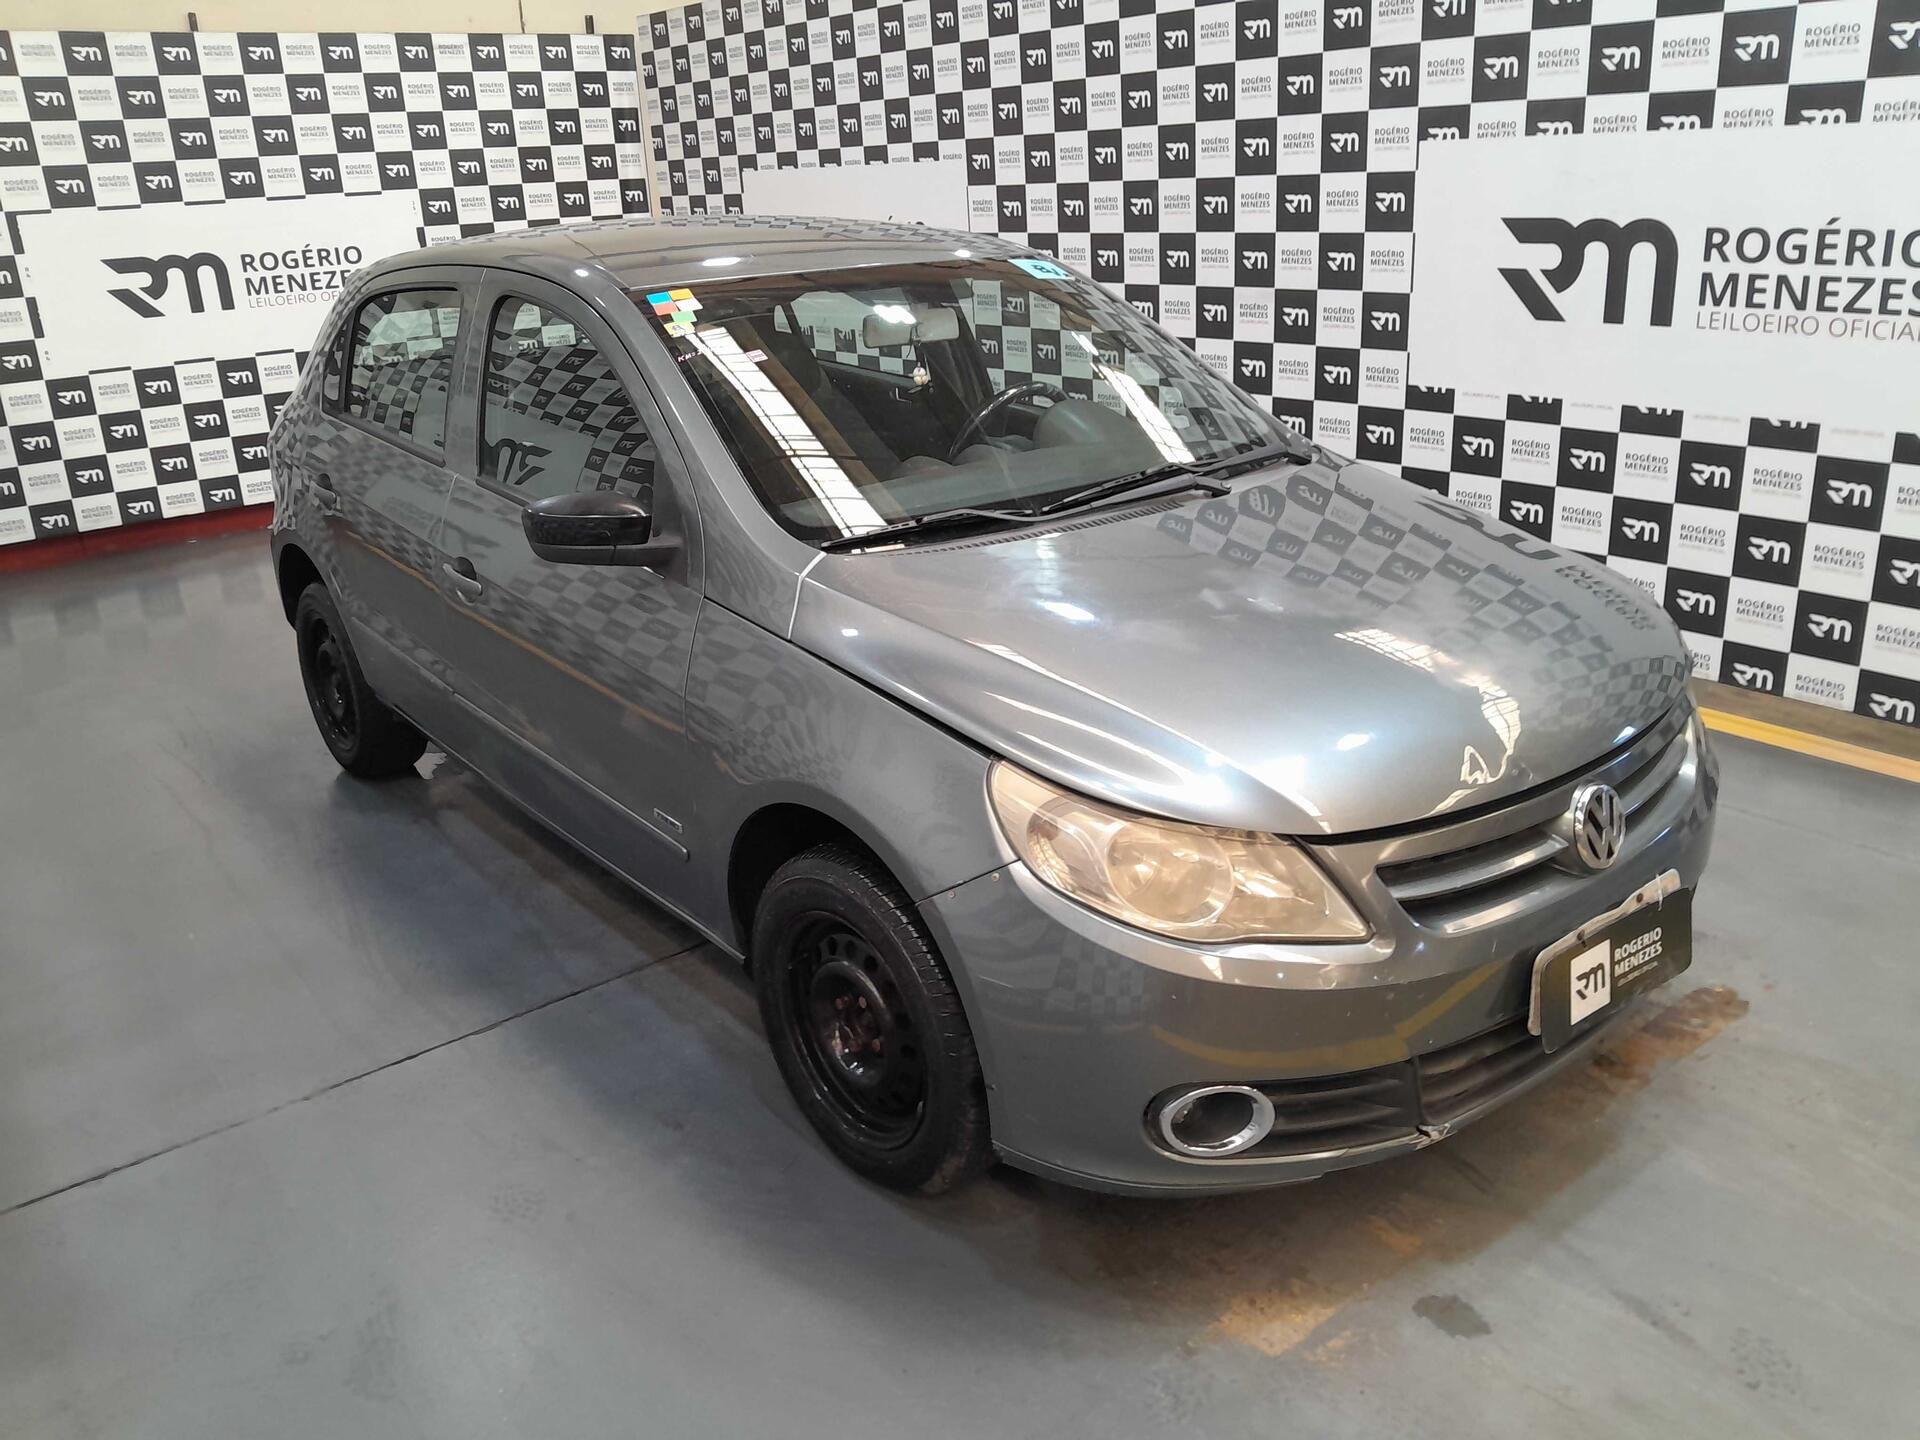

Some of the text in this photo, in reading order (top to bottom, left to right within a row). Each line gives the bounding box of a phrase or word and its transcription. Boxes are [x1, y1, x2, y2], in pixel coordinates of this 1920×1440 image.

[1285, 18, 1317, 29] MENEZES
[1804, 35, 1860, 48] MENEZES
[1662, 47, 1710, 59] MENEZES
[1537, 57, 1580, 69] MENEZES
[1427, 67, 1465, 77] MENEZES
[1330, 75, 1363, 86] MENEZES
[1375, 136, 1410, 145] MENEZES
[240, 244, 363, 273] ROGÉRIO
[244, 269, 351, 296] MENEZE
[248, 292, 317, 308] LEILOEIRO
[1696, 311, 1920, 342] LEILOEIRO OFICIA
[1366, 375, 1399, 383] MENEZES
[1410, 435, 1445, 446] MENEZES
[1511, 448, 1550, 459] MENEZES
[1624, 462, 1669, 474] MENEZES
[1753, 478, 1803, 492] MENEZES
[1561, 515, 1602, 528] MENEZES
[1679, 533, 1726, 547] MENEZES
[1812, 554, 1864, 570] MENEZES
[1736, 606, 1784, 623] MENEZES
[1794, 684, 1845, 702] MENEZES
[1614, 941, 1662, 978] MENEZES
